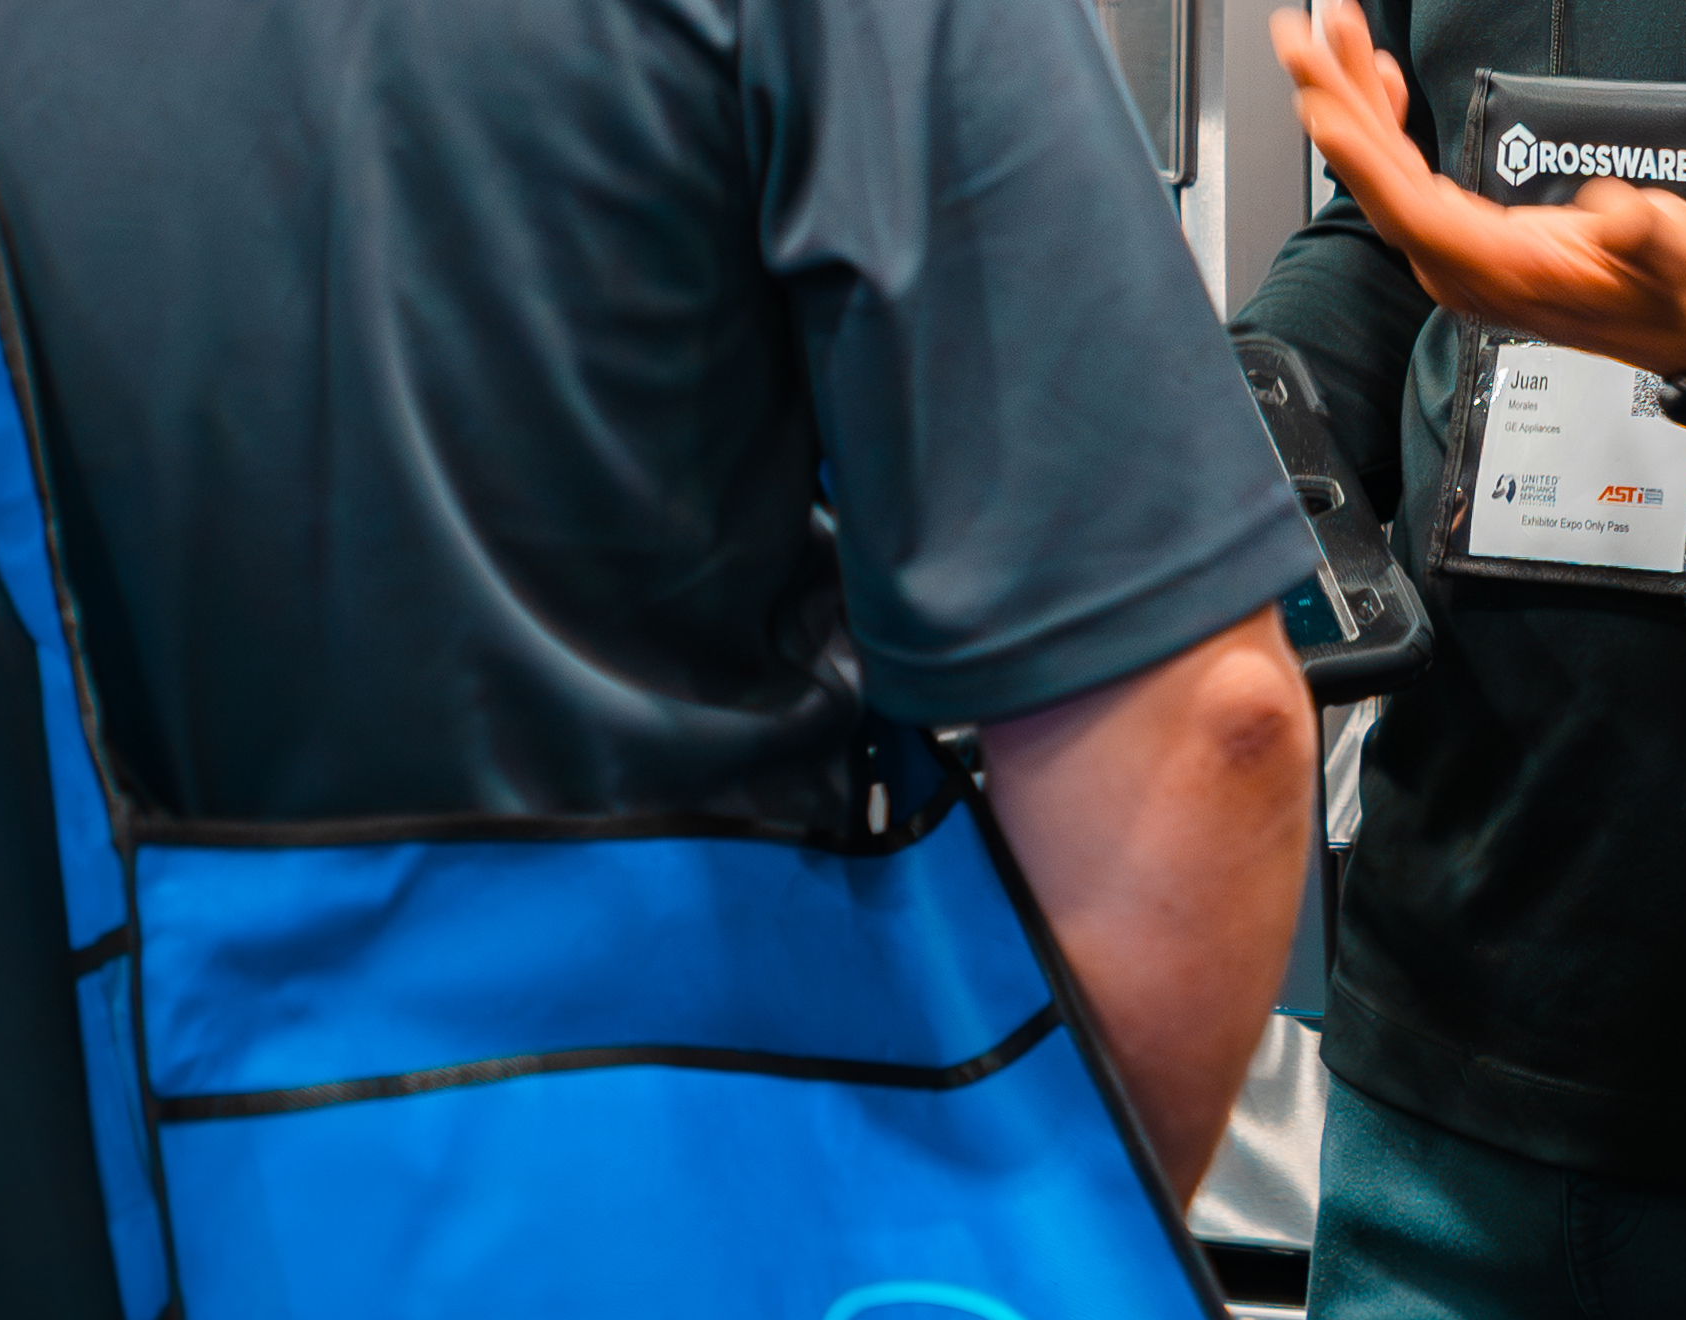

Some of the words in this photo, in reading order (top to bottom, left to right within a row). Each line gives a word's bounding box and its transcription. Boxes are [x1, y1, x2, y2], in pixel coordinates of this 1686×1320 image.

[1510, 370, 1548, 391] Juan
[1508, 399, 1538, 411] Morales
[1505, 421, 1517, 432] GE
[1519, 422, 1561, 434] Appliances
[1521, 474, 1558, 486] UNITED
[1521, 514, 1558, 528] Exhibitor
[1560, 517, 1583, 532] Expo
[1584, 519, 1605, 535] Only
[1608, 520, 1630, 533] Pass
